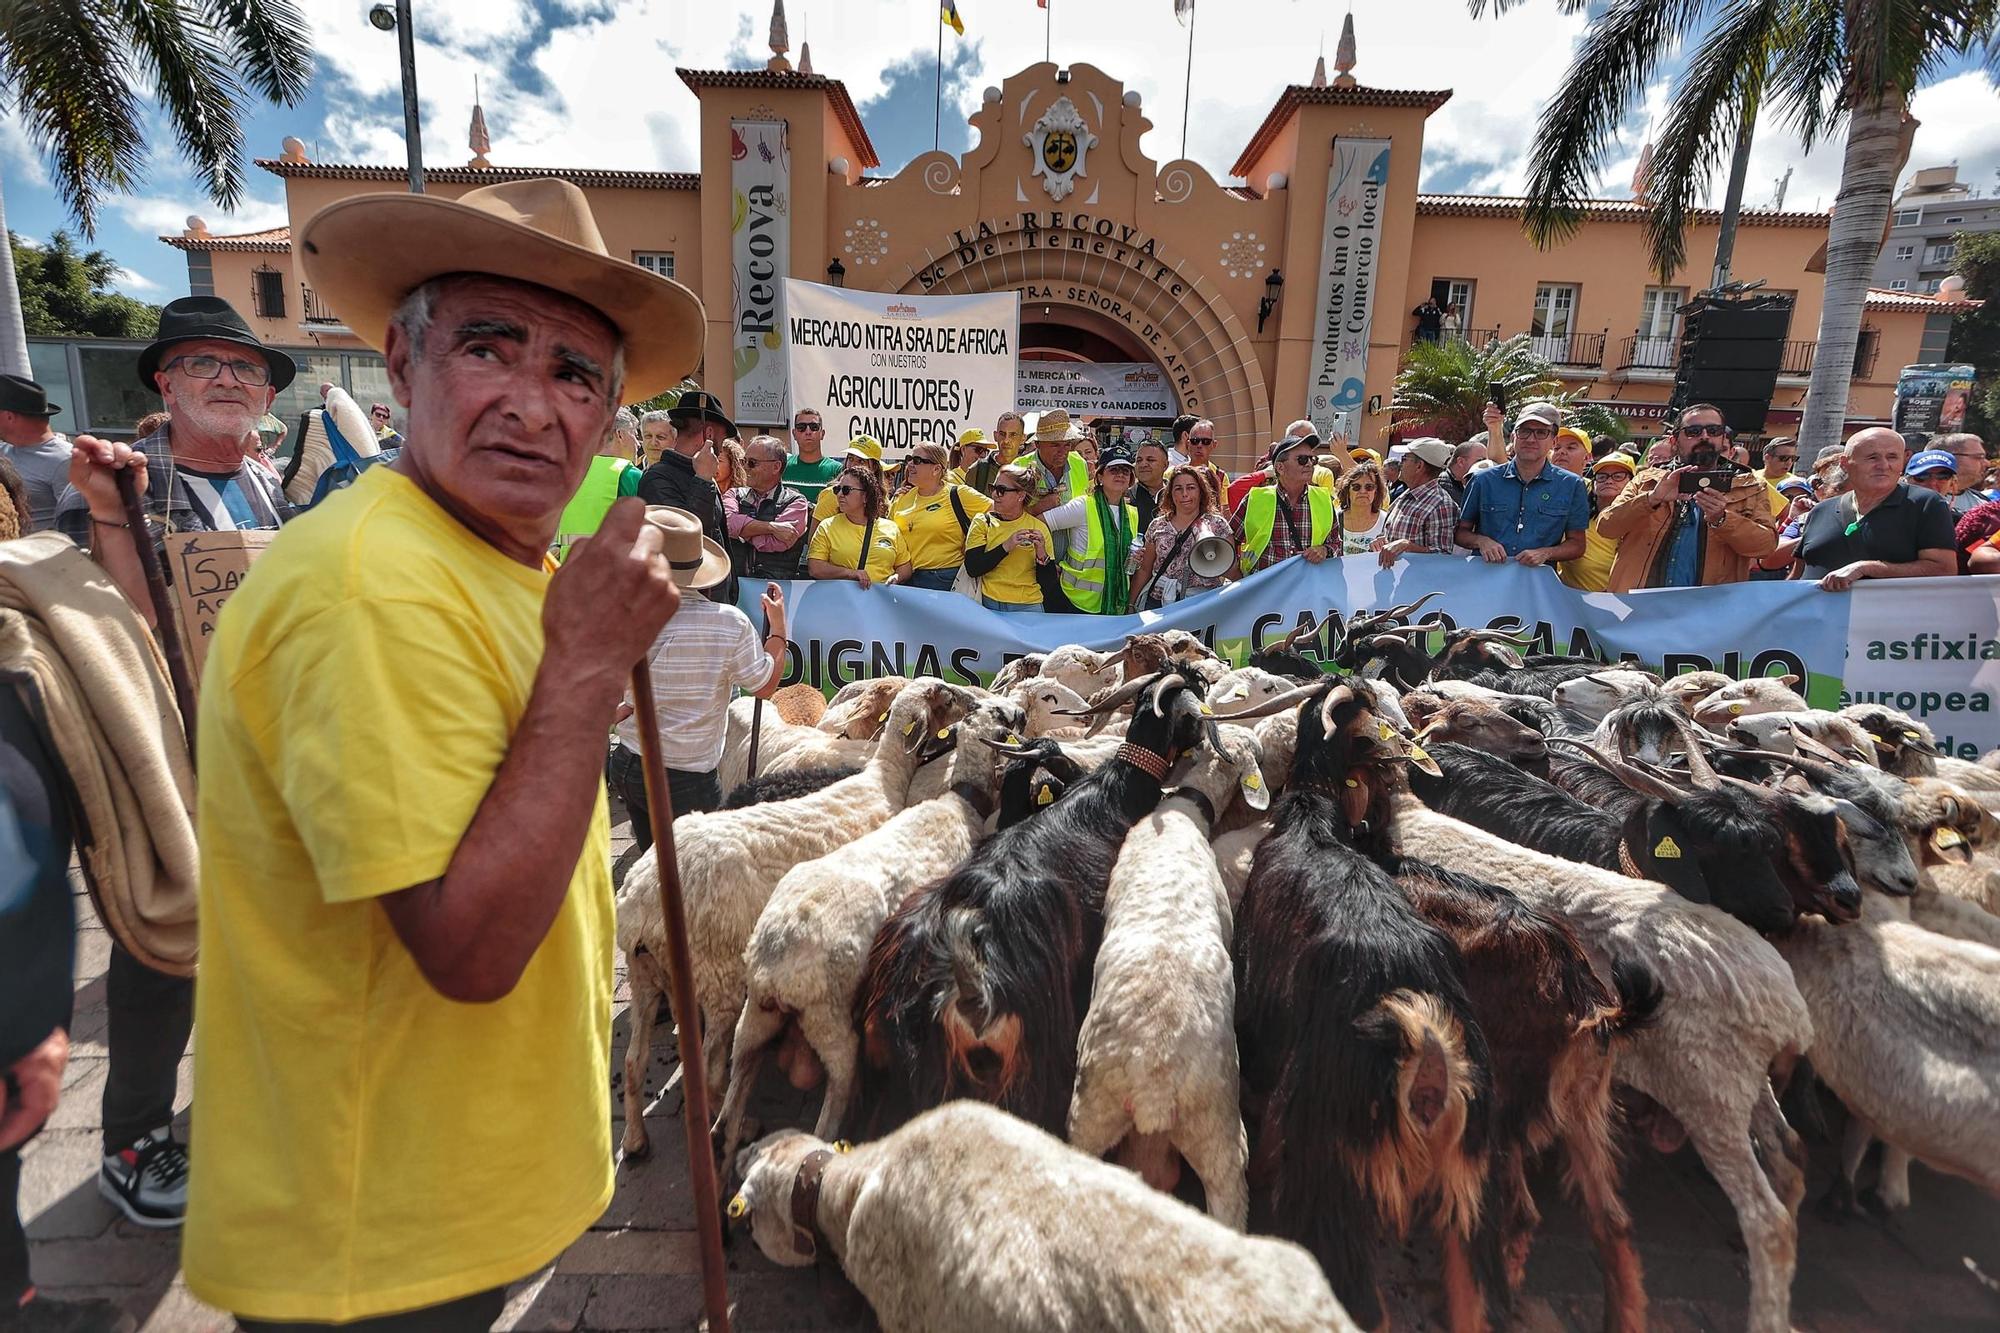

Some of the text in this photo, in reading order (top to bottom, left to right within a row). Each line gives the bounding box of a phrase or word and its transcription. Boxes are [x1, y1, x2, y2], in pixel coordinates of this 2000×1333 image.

[954, 211, 1156, 258] LA RECOVA
[741, 183, 775, 335] Recova
[918, 231, 1182, 297] S/c De Tenerife
[1329, 244, 1349, 279] km
[1347, 180, 1380, 334] Comercio local
[790, 317, 1008, 355] MERCADO NTRA SRA DE AFRICA
[1067, 286, 1132, 324] SEÑORA
[1142, 323, 1162, 345] DE
[1164, 353, 1201, 417] AFRIC
[1319, 280, 1346, 388] Productos
[871, 353, 927, 370] CON NUESTROS
[1029, 370, 1082, 381] MERCADO
[826, 374, 974, 420] AGRICULTORES y
[1024, 384, 1105, 396] SRA. DE ÁFRICA
[1092, 401, 1099, 409] Y
[1101, 401, 1167, 411] GANADEROS
[777, 639, 982, 691] DIGNAS
[1866, 632, 2000, 661] asfixia
[1838, 690, 1990, 718] europea
[1935, 735, 1979, 761] de
